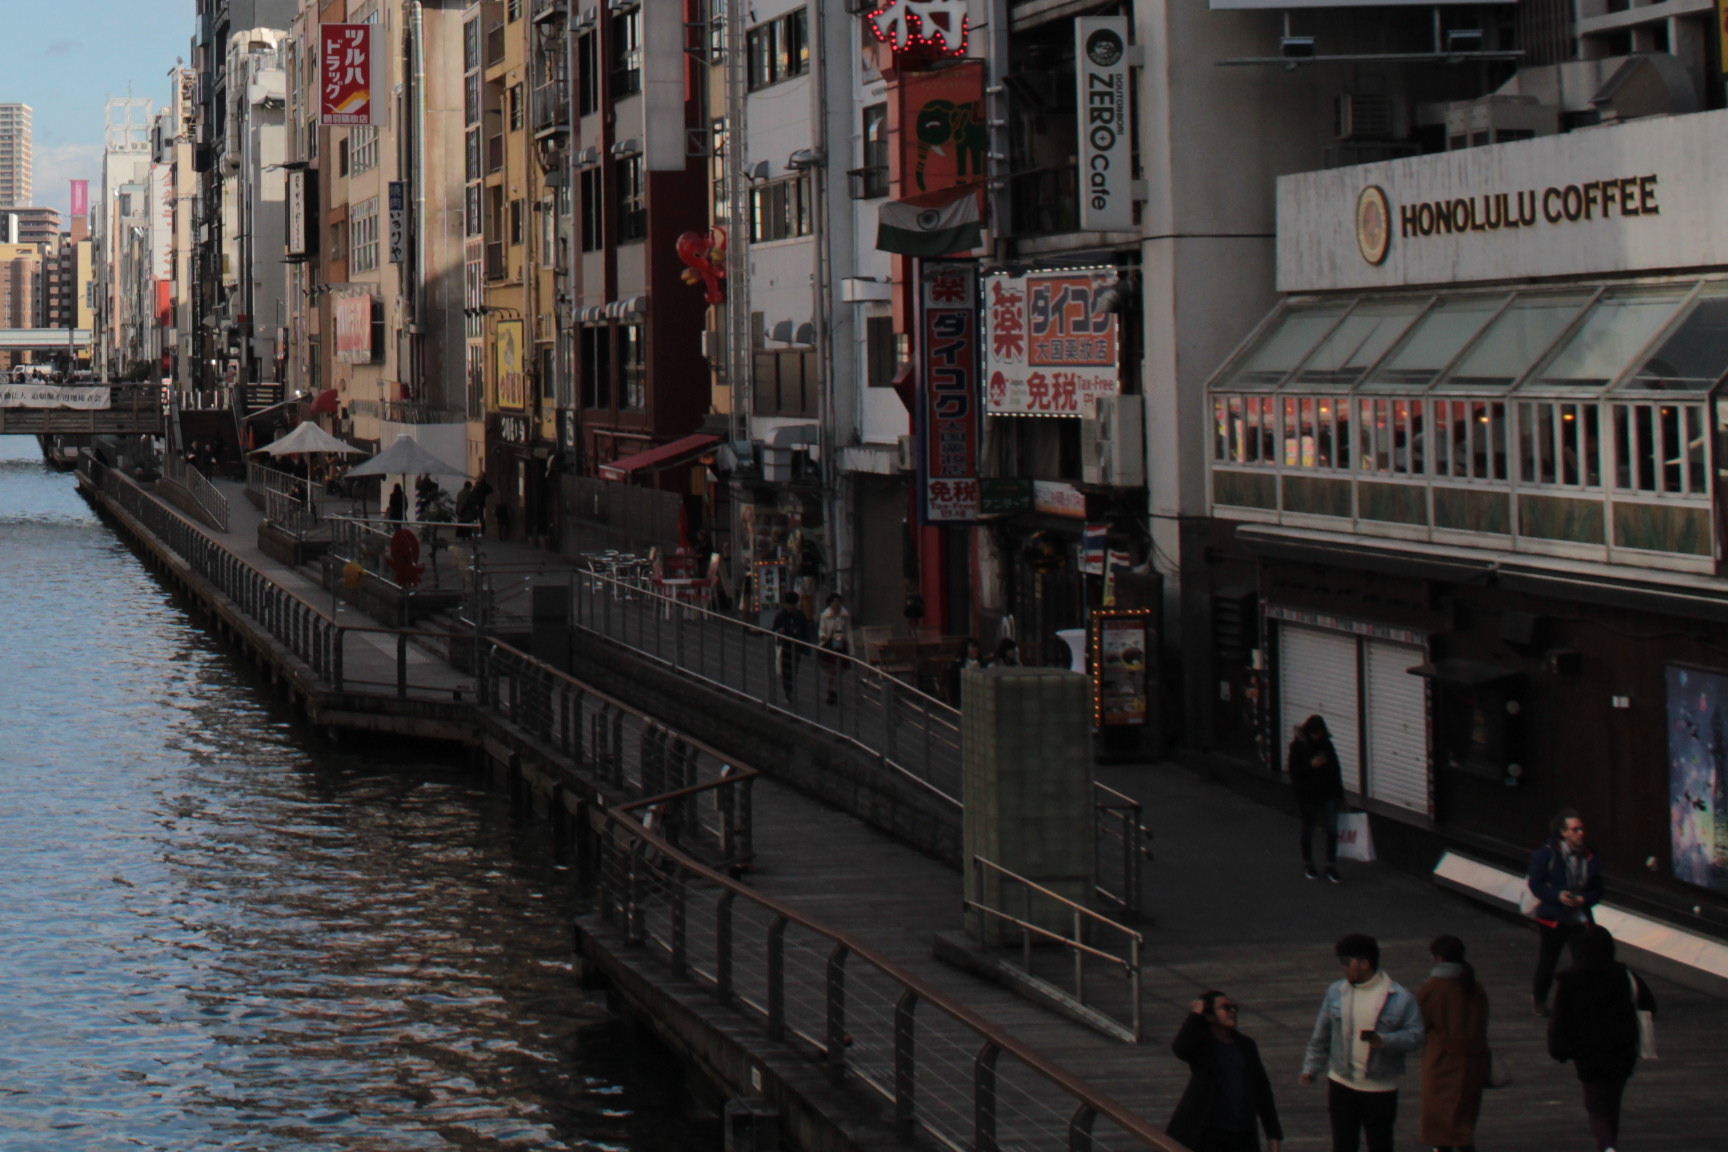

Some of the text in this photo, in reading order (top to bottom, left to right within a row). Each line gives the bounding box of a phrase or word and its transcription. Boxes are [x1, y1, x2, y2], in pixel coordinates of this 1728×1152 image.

[325, 39, 344, 100] ドラッグ
[344, 29, 366, 85] ツルハ
[1088, 73, 1116, 153] ZERO
[1400, 174, 1660, 238] HONOLULU COFFEE
[933, 312, 968, 420] ダイコク
[1026, 372, 1077, 410] 免税
[928, 479, 976, 503] 免税
